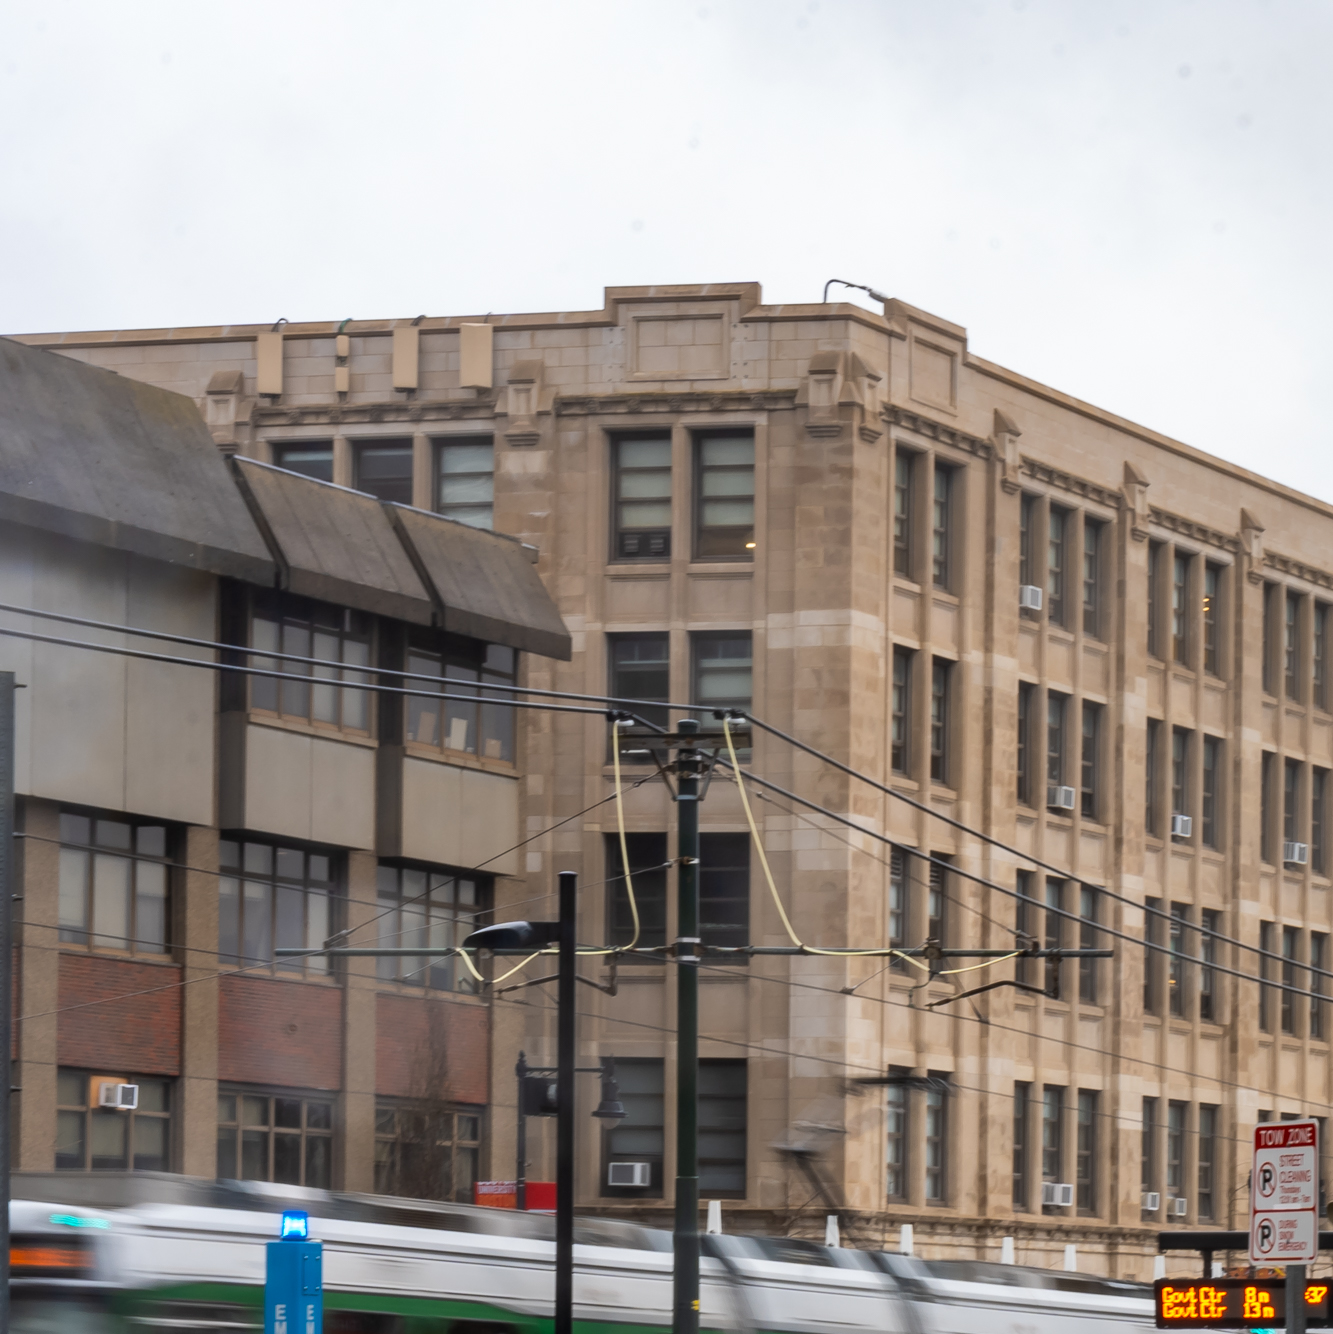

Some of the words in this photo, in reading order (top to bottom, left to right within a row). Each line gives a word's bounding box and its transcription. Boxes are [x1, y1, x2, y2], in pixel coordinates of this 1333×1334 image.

[1259, 1129, 1285, 1146] TOW
[1287, 1126, 1314, 1145] ZONE
[1279, 1153, 1305, 1168] STREET
[1279, 1169, 1312, 1183] CLEANING
[1161, 1286, 1198, 1304] Govt
[1198, 1286, 1227, 1304] Ctr
[1161, 1302, 1198, 1319] Govt
[1198, 1302, 1228, 1319] Ctr
